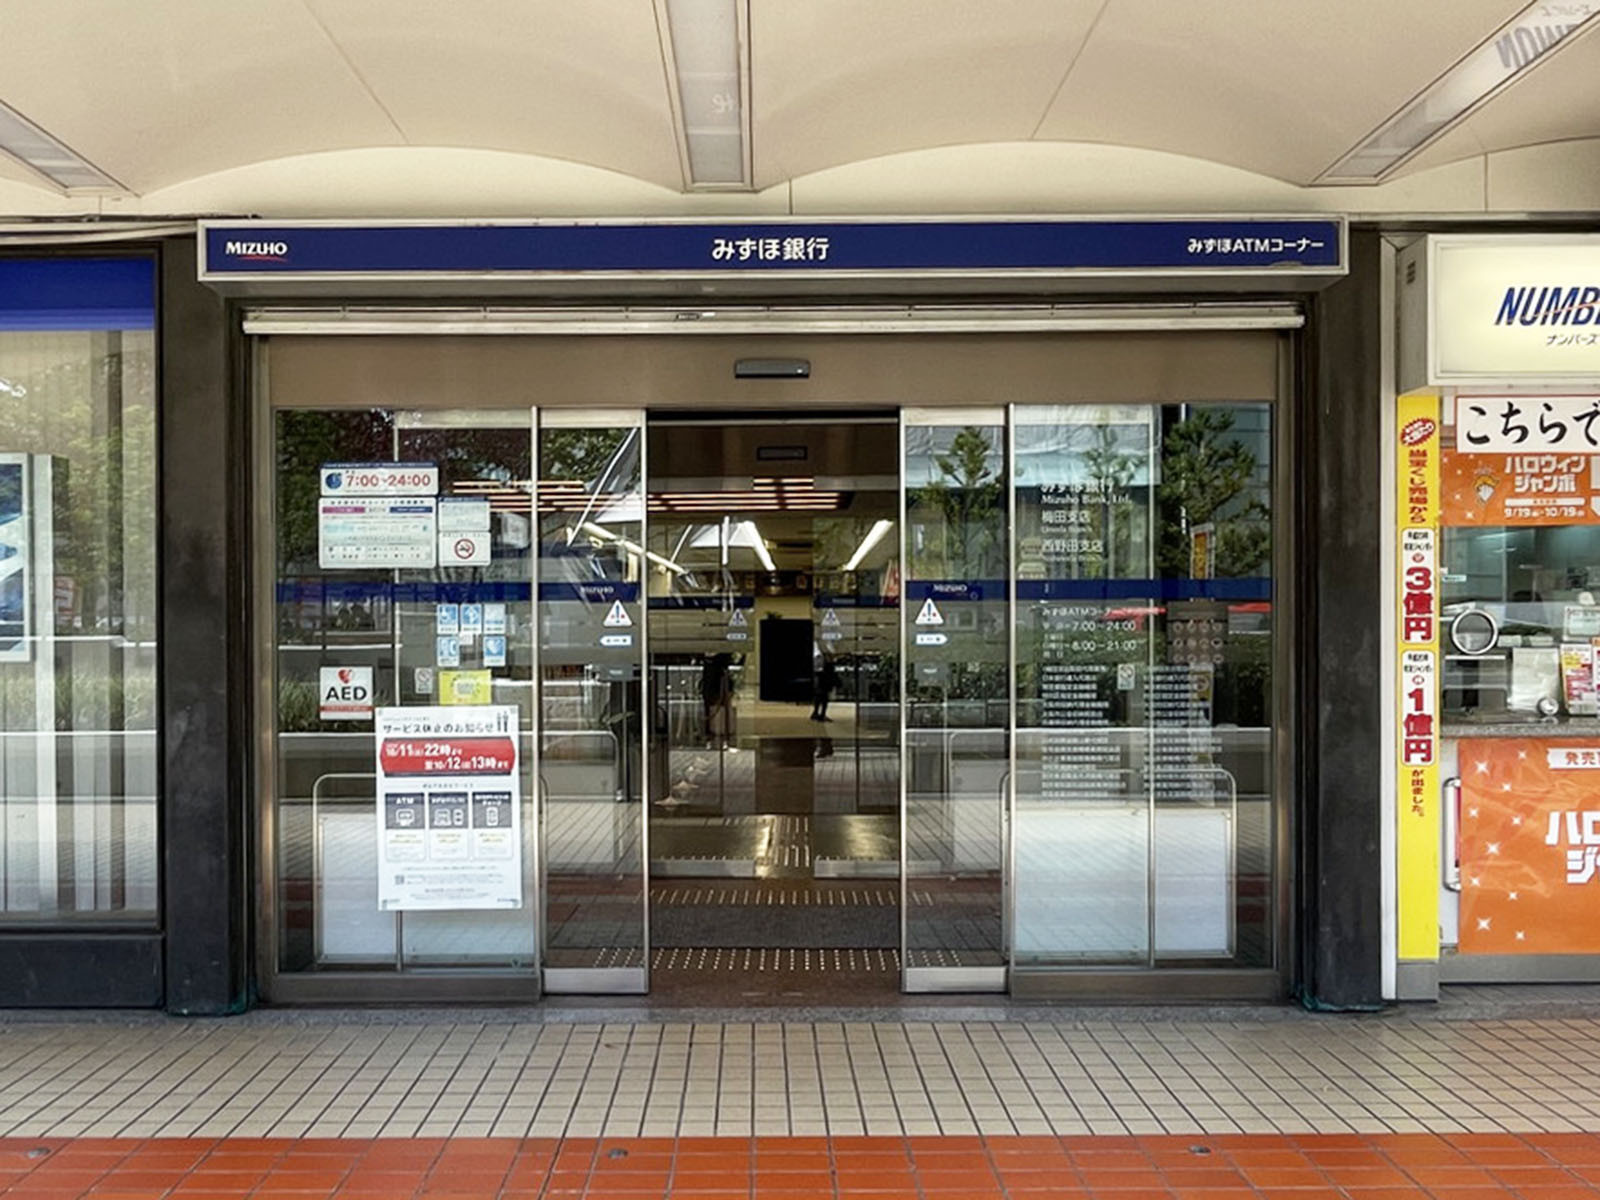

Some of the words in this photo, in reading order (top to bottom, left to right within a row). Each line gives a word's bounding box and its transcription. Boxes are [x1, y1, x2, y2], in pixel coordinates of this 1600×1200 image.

[225, 241, 288, 255] MIZUHO
[712, 237, 829, 260] みずほ銀行
[1187, 238, 1324, 253] みずほATMコーナー
[1466, 401, 1600, 446] こちらで
[1504, 455, 1586, 473] ハロウィン
[1514, 473, 1576, 492] ジャンボ
[1404, 566, 1433, 641] 3億円
[326, 686, 368, 701] AED
[383, 723, 494, 734] サービス休止のお知らせ
[1404, 687, 1433, 762] 1億円
[1565, 751, 1600, 765] 発売
[1566, 846, 1600, 884] ジ
